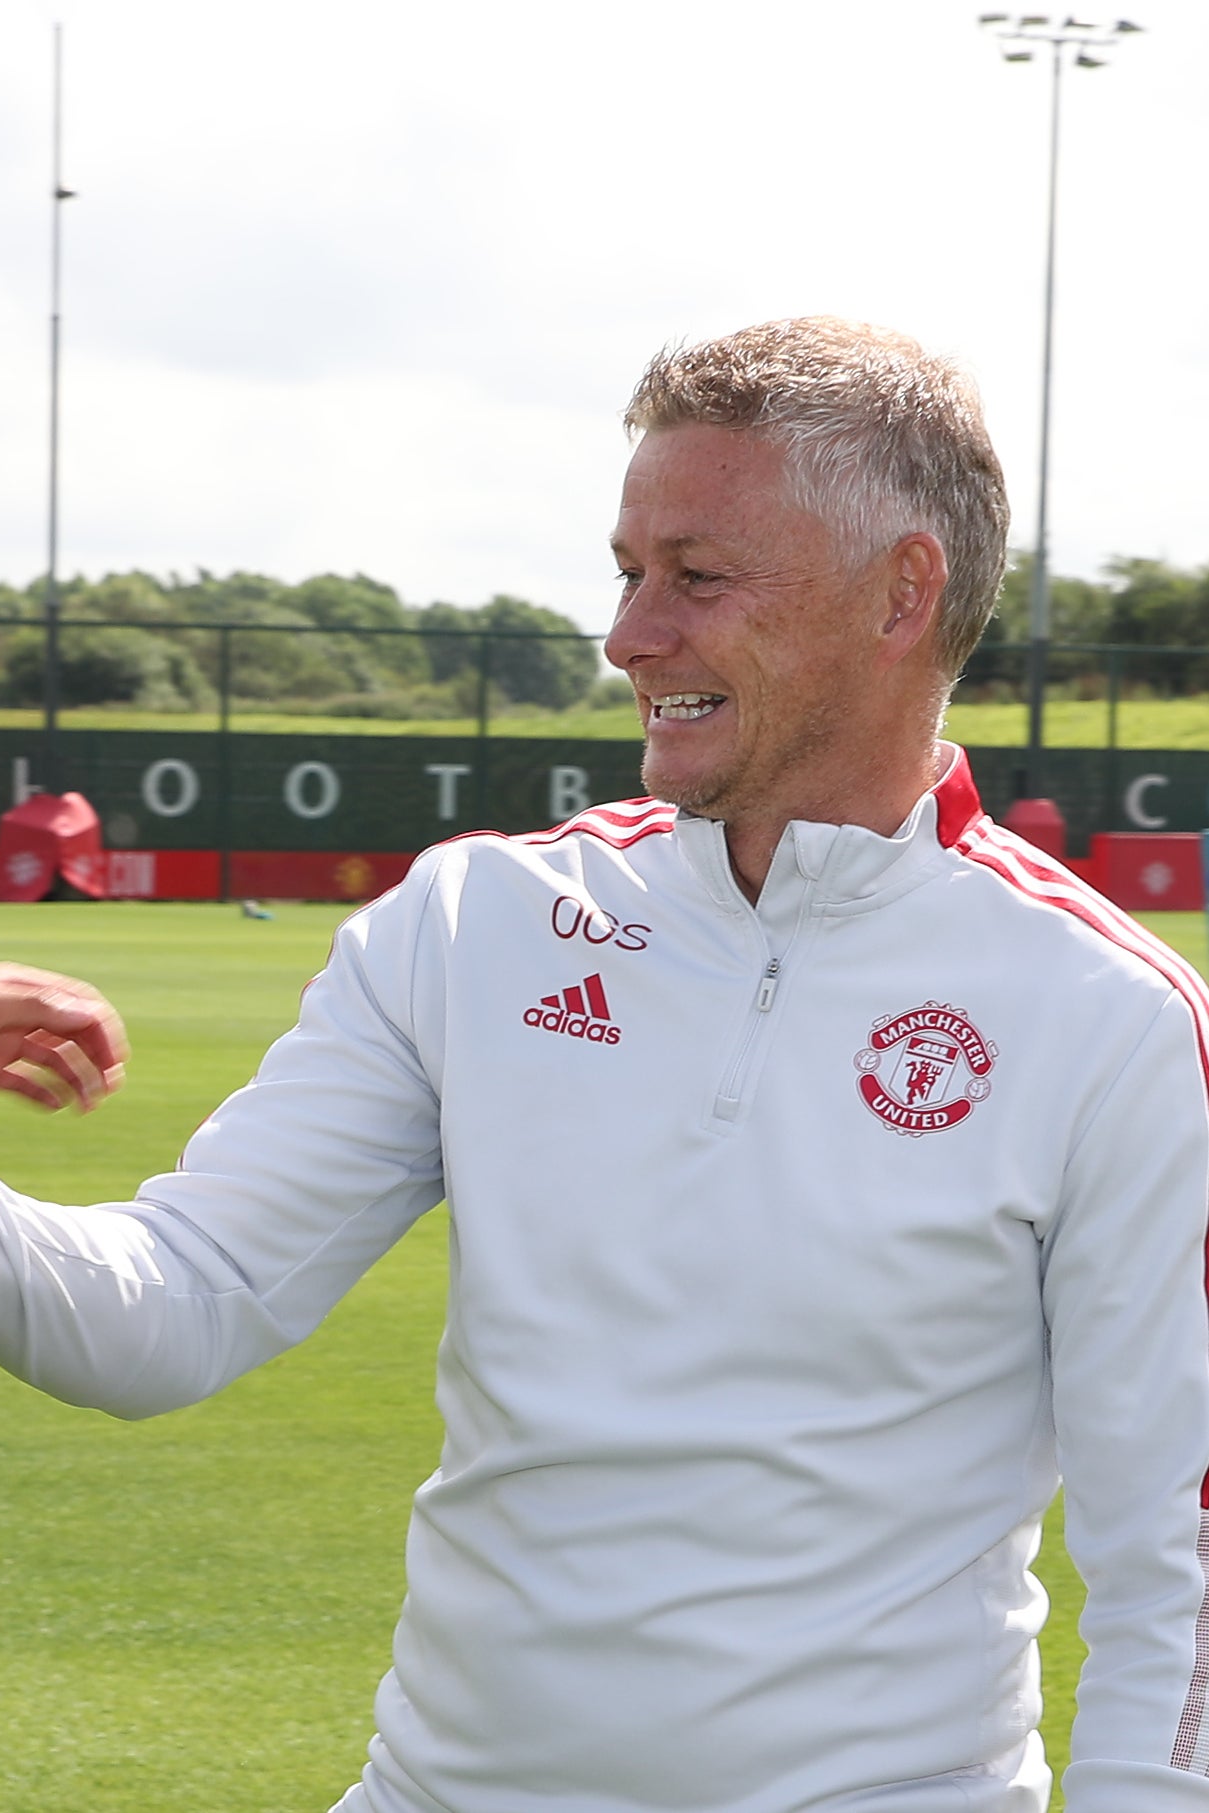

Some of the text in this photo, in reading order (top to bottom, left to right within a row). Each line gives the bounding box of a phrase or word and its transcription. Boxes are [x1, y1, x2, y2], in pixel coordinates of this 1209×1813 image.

[551, 895, 653, 951] OGS
[523, 1007, 623, 1045] adidas
[879, 1012, 987, 1069] MANCHESTER
[871, 1094, 950, 1128] UNITED
